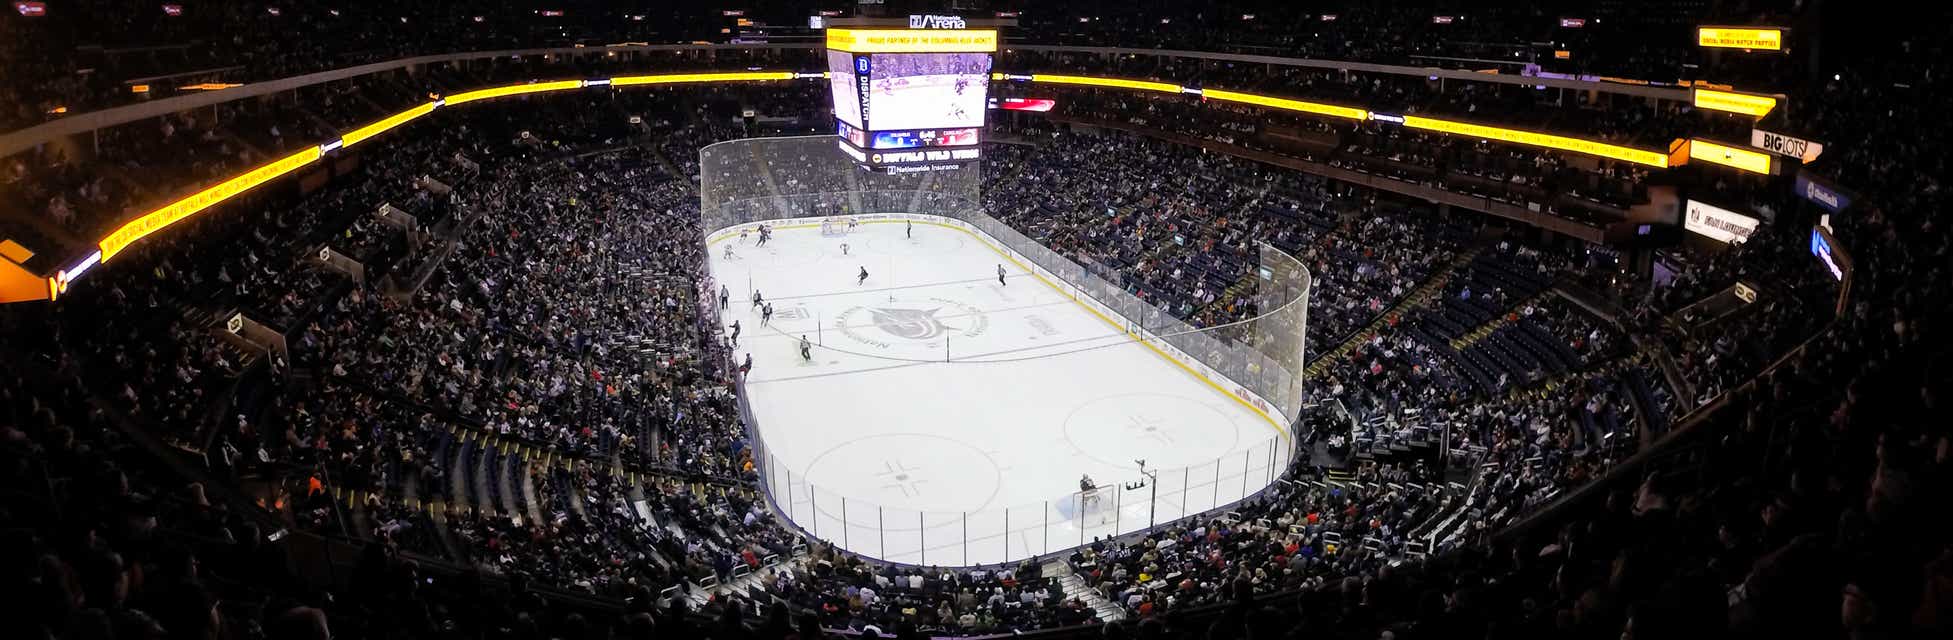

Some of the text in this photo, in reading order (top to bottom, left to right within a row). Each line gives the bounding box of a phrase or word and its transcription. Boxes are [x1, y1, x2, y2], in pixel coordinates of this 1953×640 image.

[922, 15, 966, 29] Arena
[860, 76, 870, 120] DISPATCH
[926, 150, 951, 161] WILD
[897, 165, 930, 173] Nationwide
